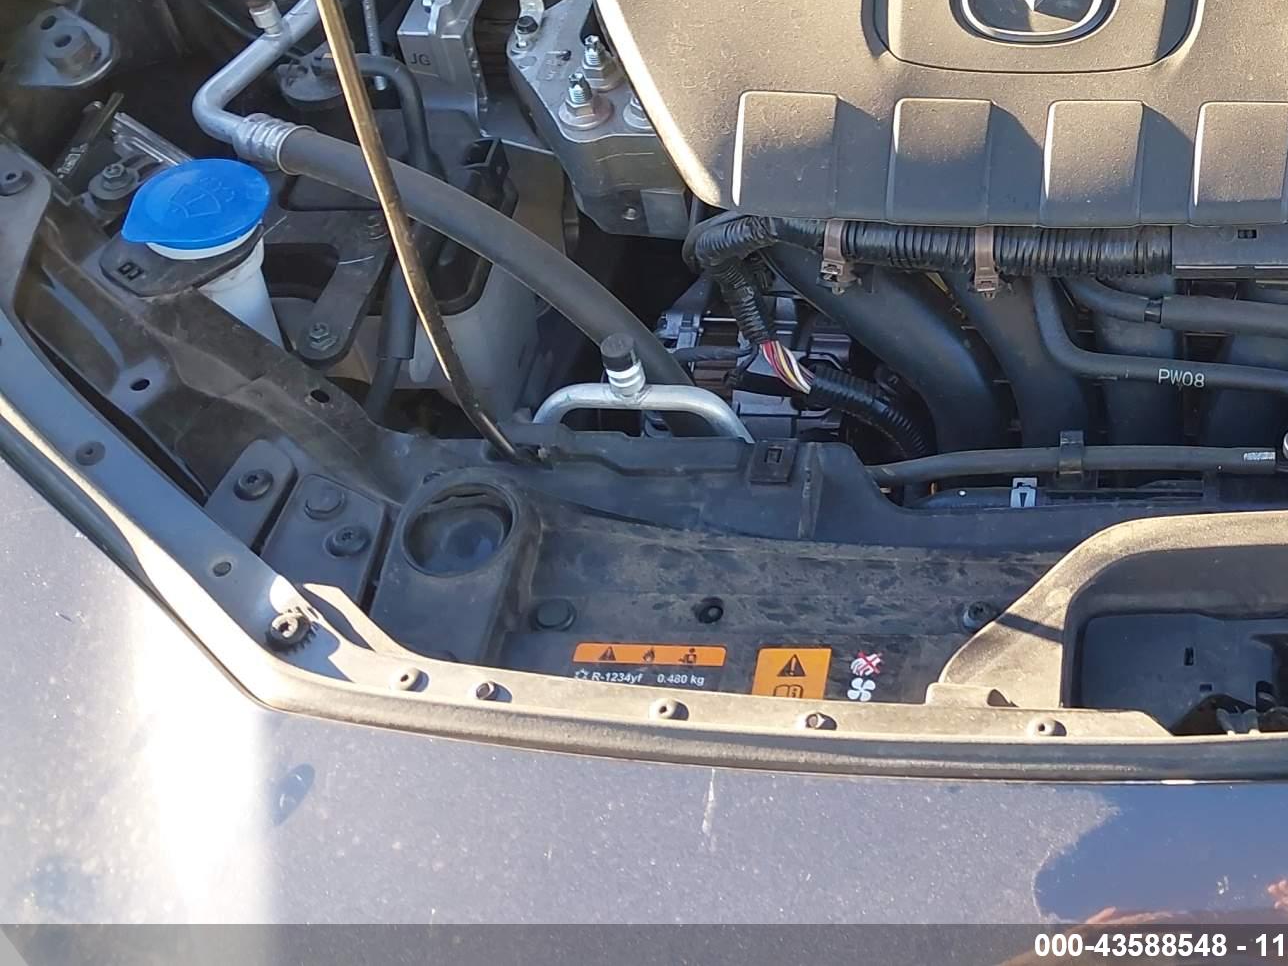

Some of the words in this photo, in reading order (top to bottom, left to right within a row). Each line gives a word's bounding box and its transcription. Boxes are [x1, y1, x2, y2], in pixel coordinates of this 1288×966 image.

[1158, 368, 1205, 388] PW08
[591, 671, 643, 684] R-1234yf
[690, 674, 705, 687] kg
